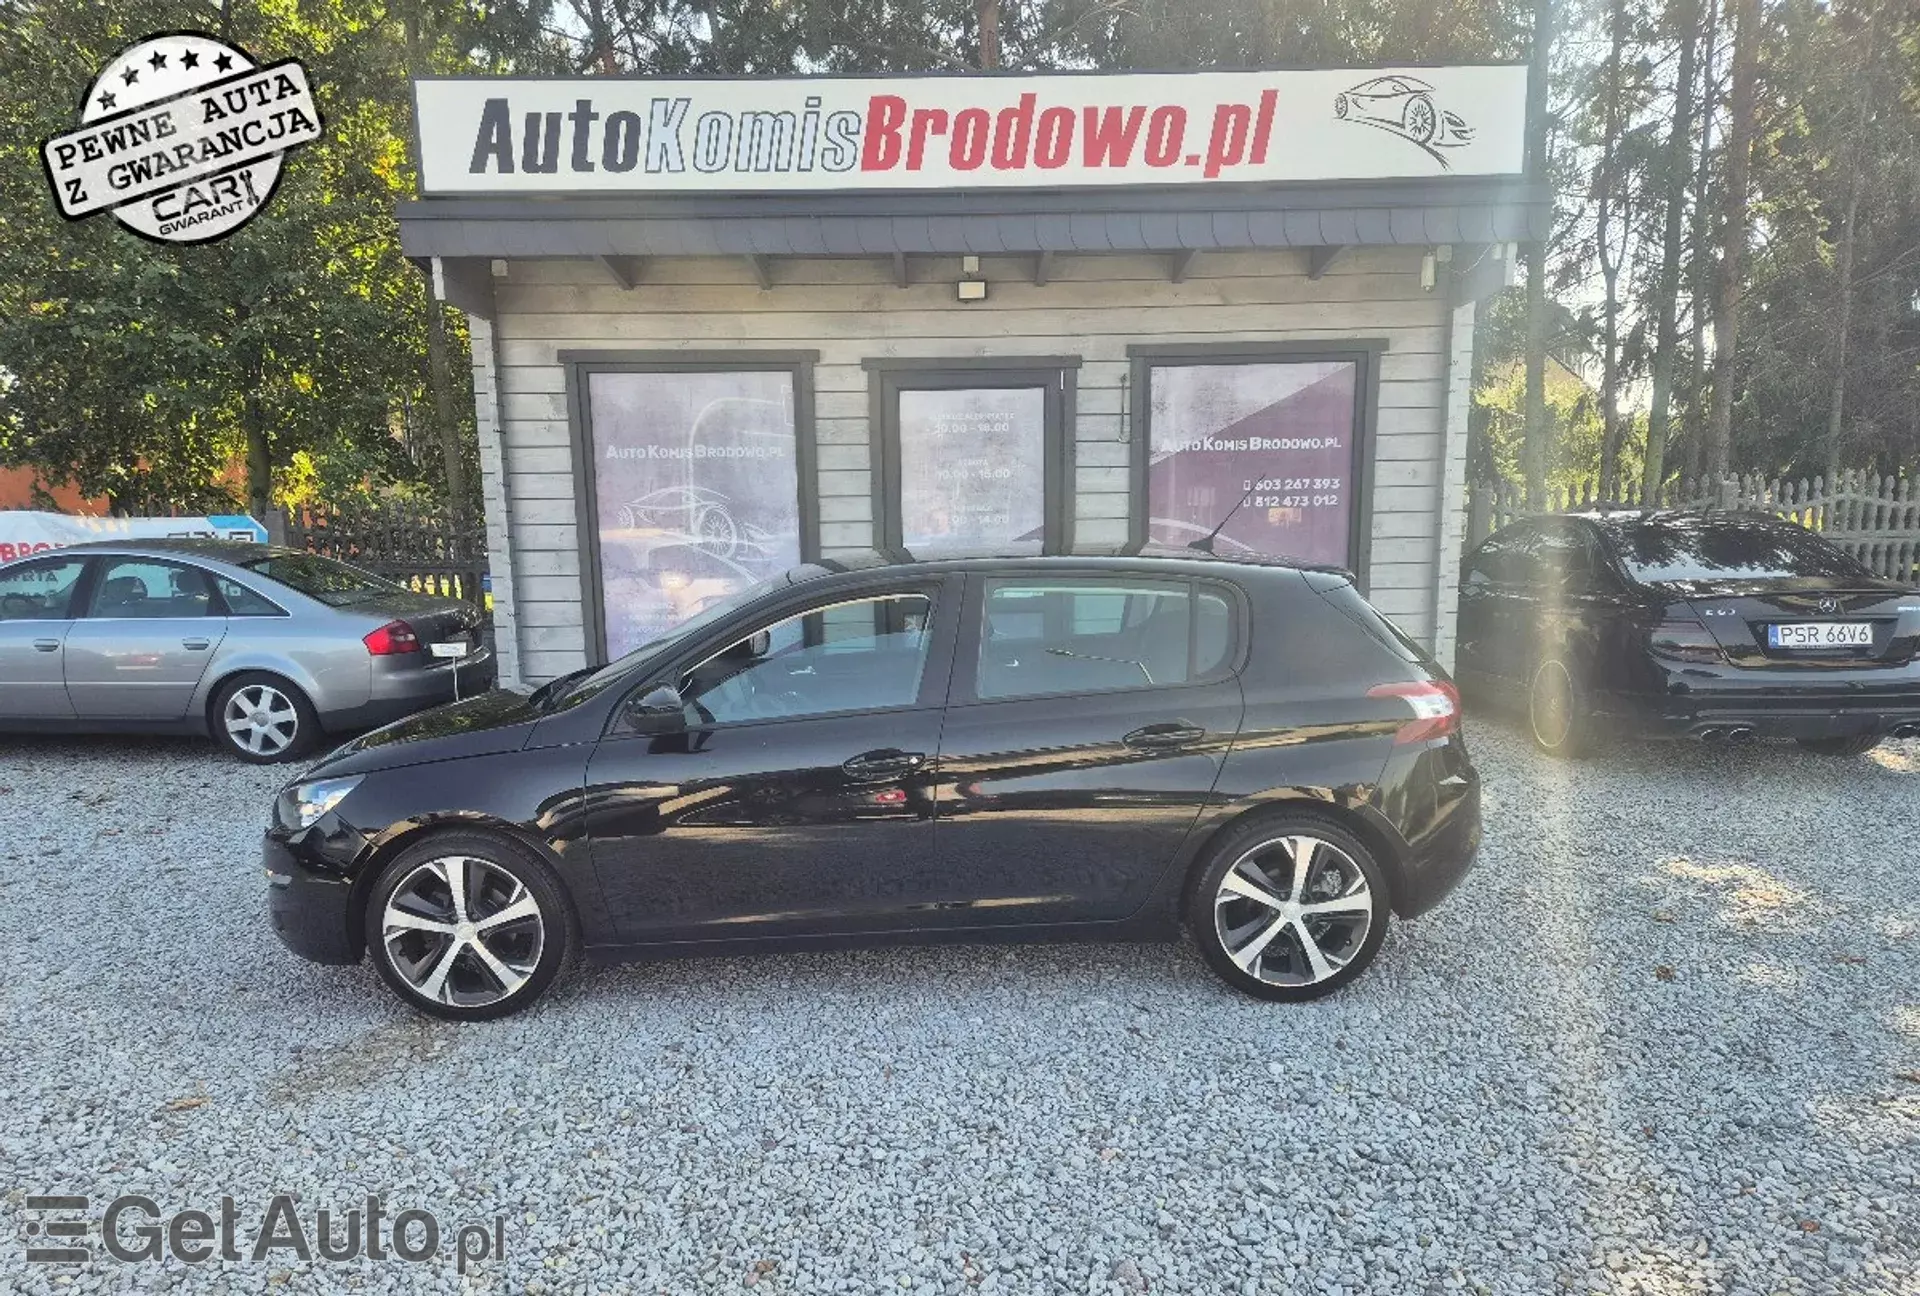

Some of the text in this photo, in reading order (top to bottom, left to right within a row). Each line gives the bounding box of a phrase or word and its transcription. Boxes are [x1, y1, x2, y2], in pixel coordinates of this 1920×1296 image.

[469, 89, 1279, 178] AutoKomisBrodowo.pl
[1284, 479, 1310, 490] 267
[1282, 496, 1309, 507] 473
[1313, 495, 1338, 506] 012
[1780, 625, 1869, 643] PSR 66V6
